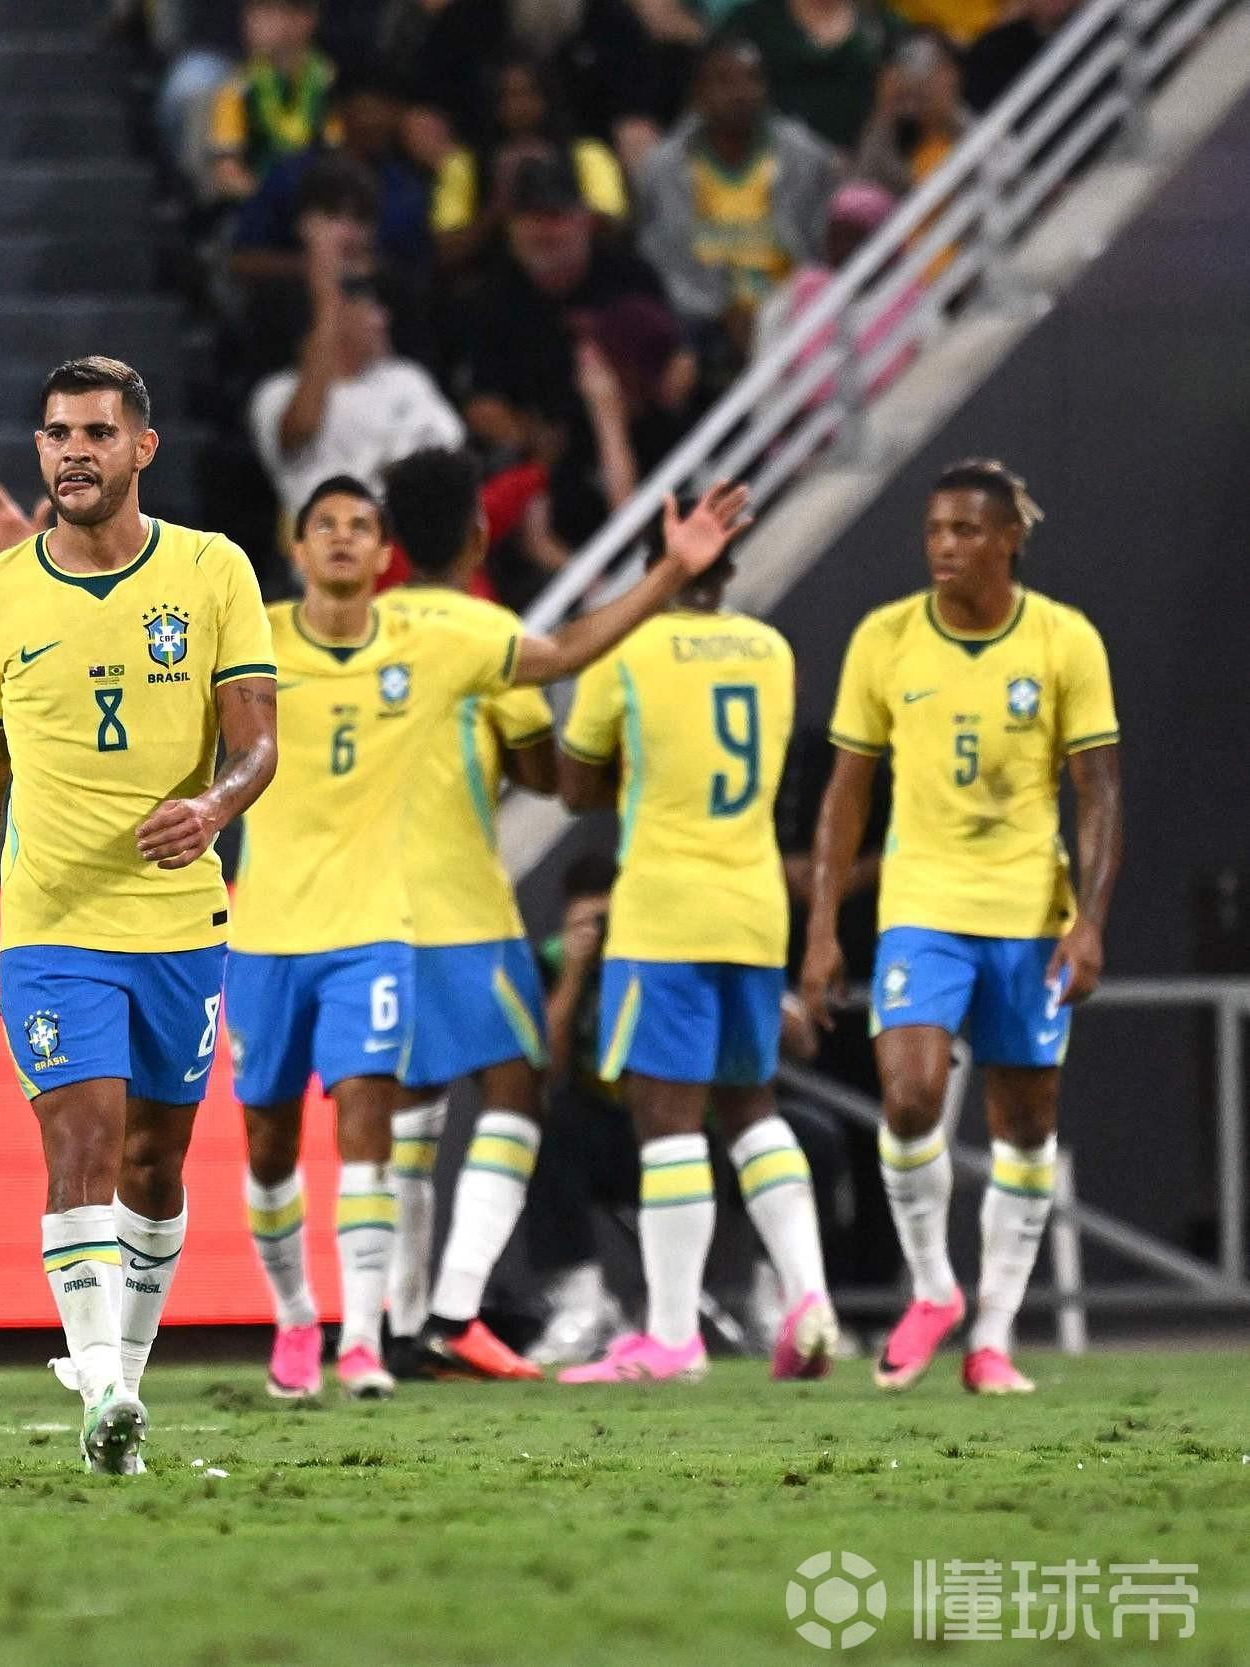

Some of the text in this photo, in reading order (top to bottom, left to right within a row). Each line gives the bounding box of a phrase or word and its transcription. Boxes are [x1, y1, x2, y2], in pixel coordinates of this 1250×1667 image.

[147, 672, 190, 684] BRASIL
[94, 688, 128, 752] 8
[330, 724, 357, 776] 6
[710, 685, 759, 818] 9
[955, 734, 979, 787] 5
[198, 992, 221, 1057] 8
[370, 975, 399, 1032] 6
[34, 1056, 69, 1072] BRASIL
[63, 1277, 102, 1293] BRASIL
[125, 1277, 162, 1294] BRASIL
